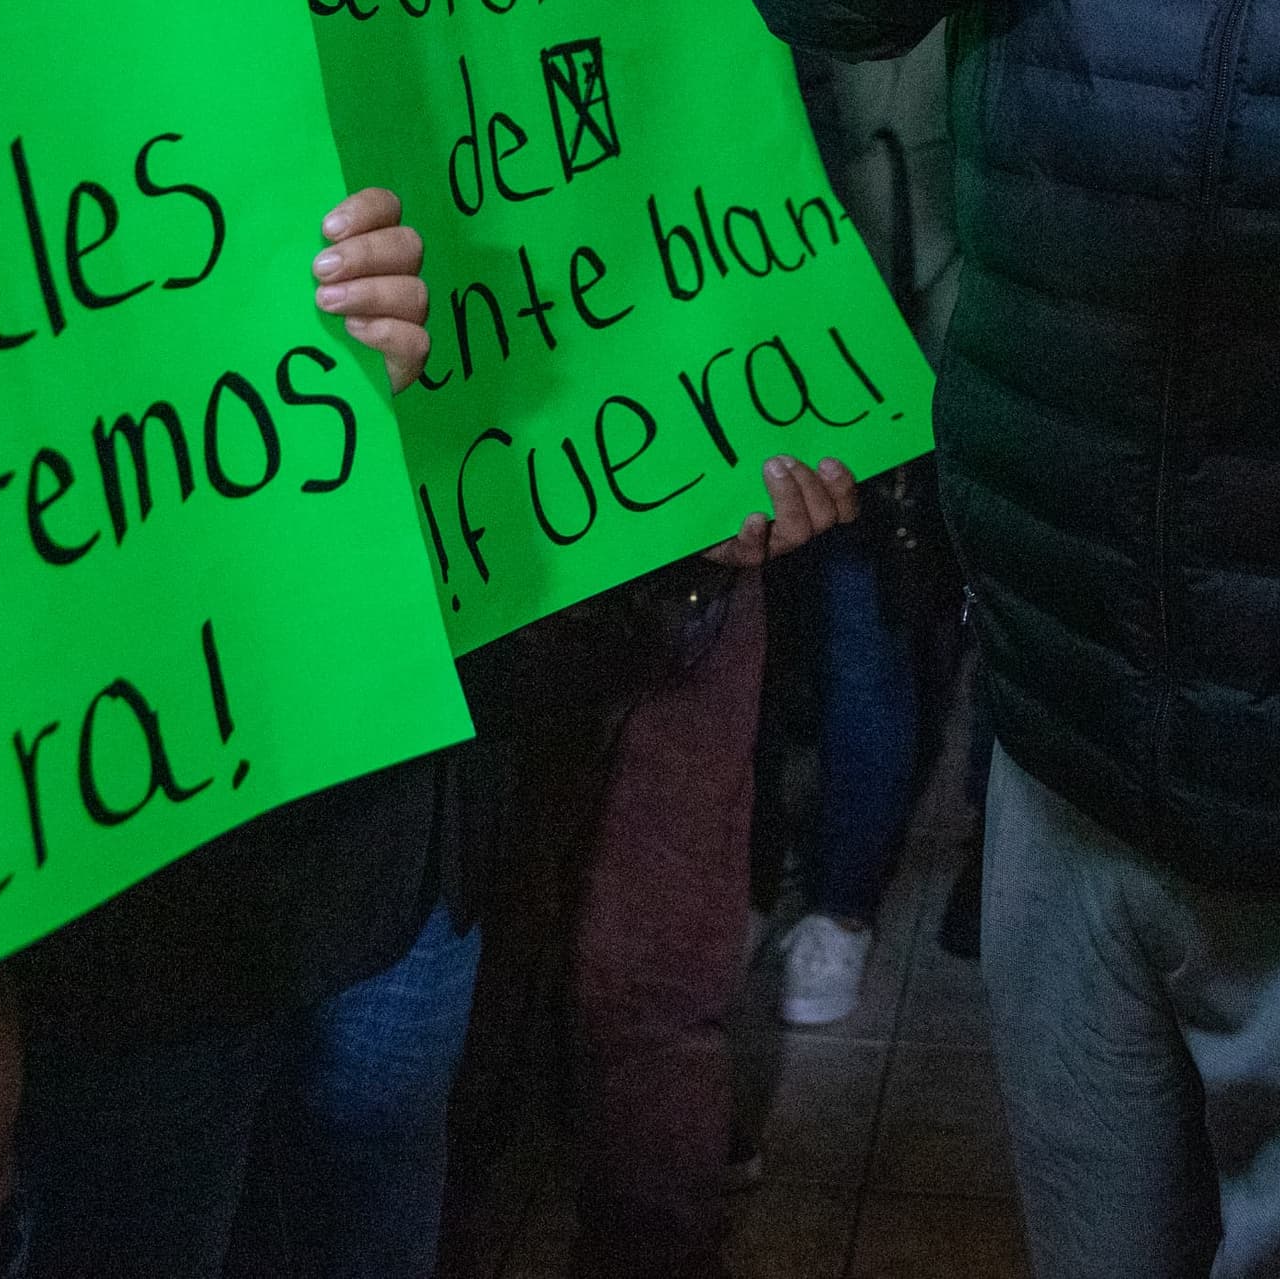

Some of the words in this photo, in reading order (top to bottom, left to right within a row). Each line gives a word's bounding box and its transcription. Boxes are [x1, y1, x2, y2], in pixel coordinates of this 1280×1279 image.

[447, 54, 553, 218] de
[418, 243, 635, 392] nte
[646, 184, 850, 292] blan
